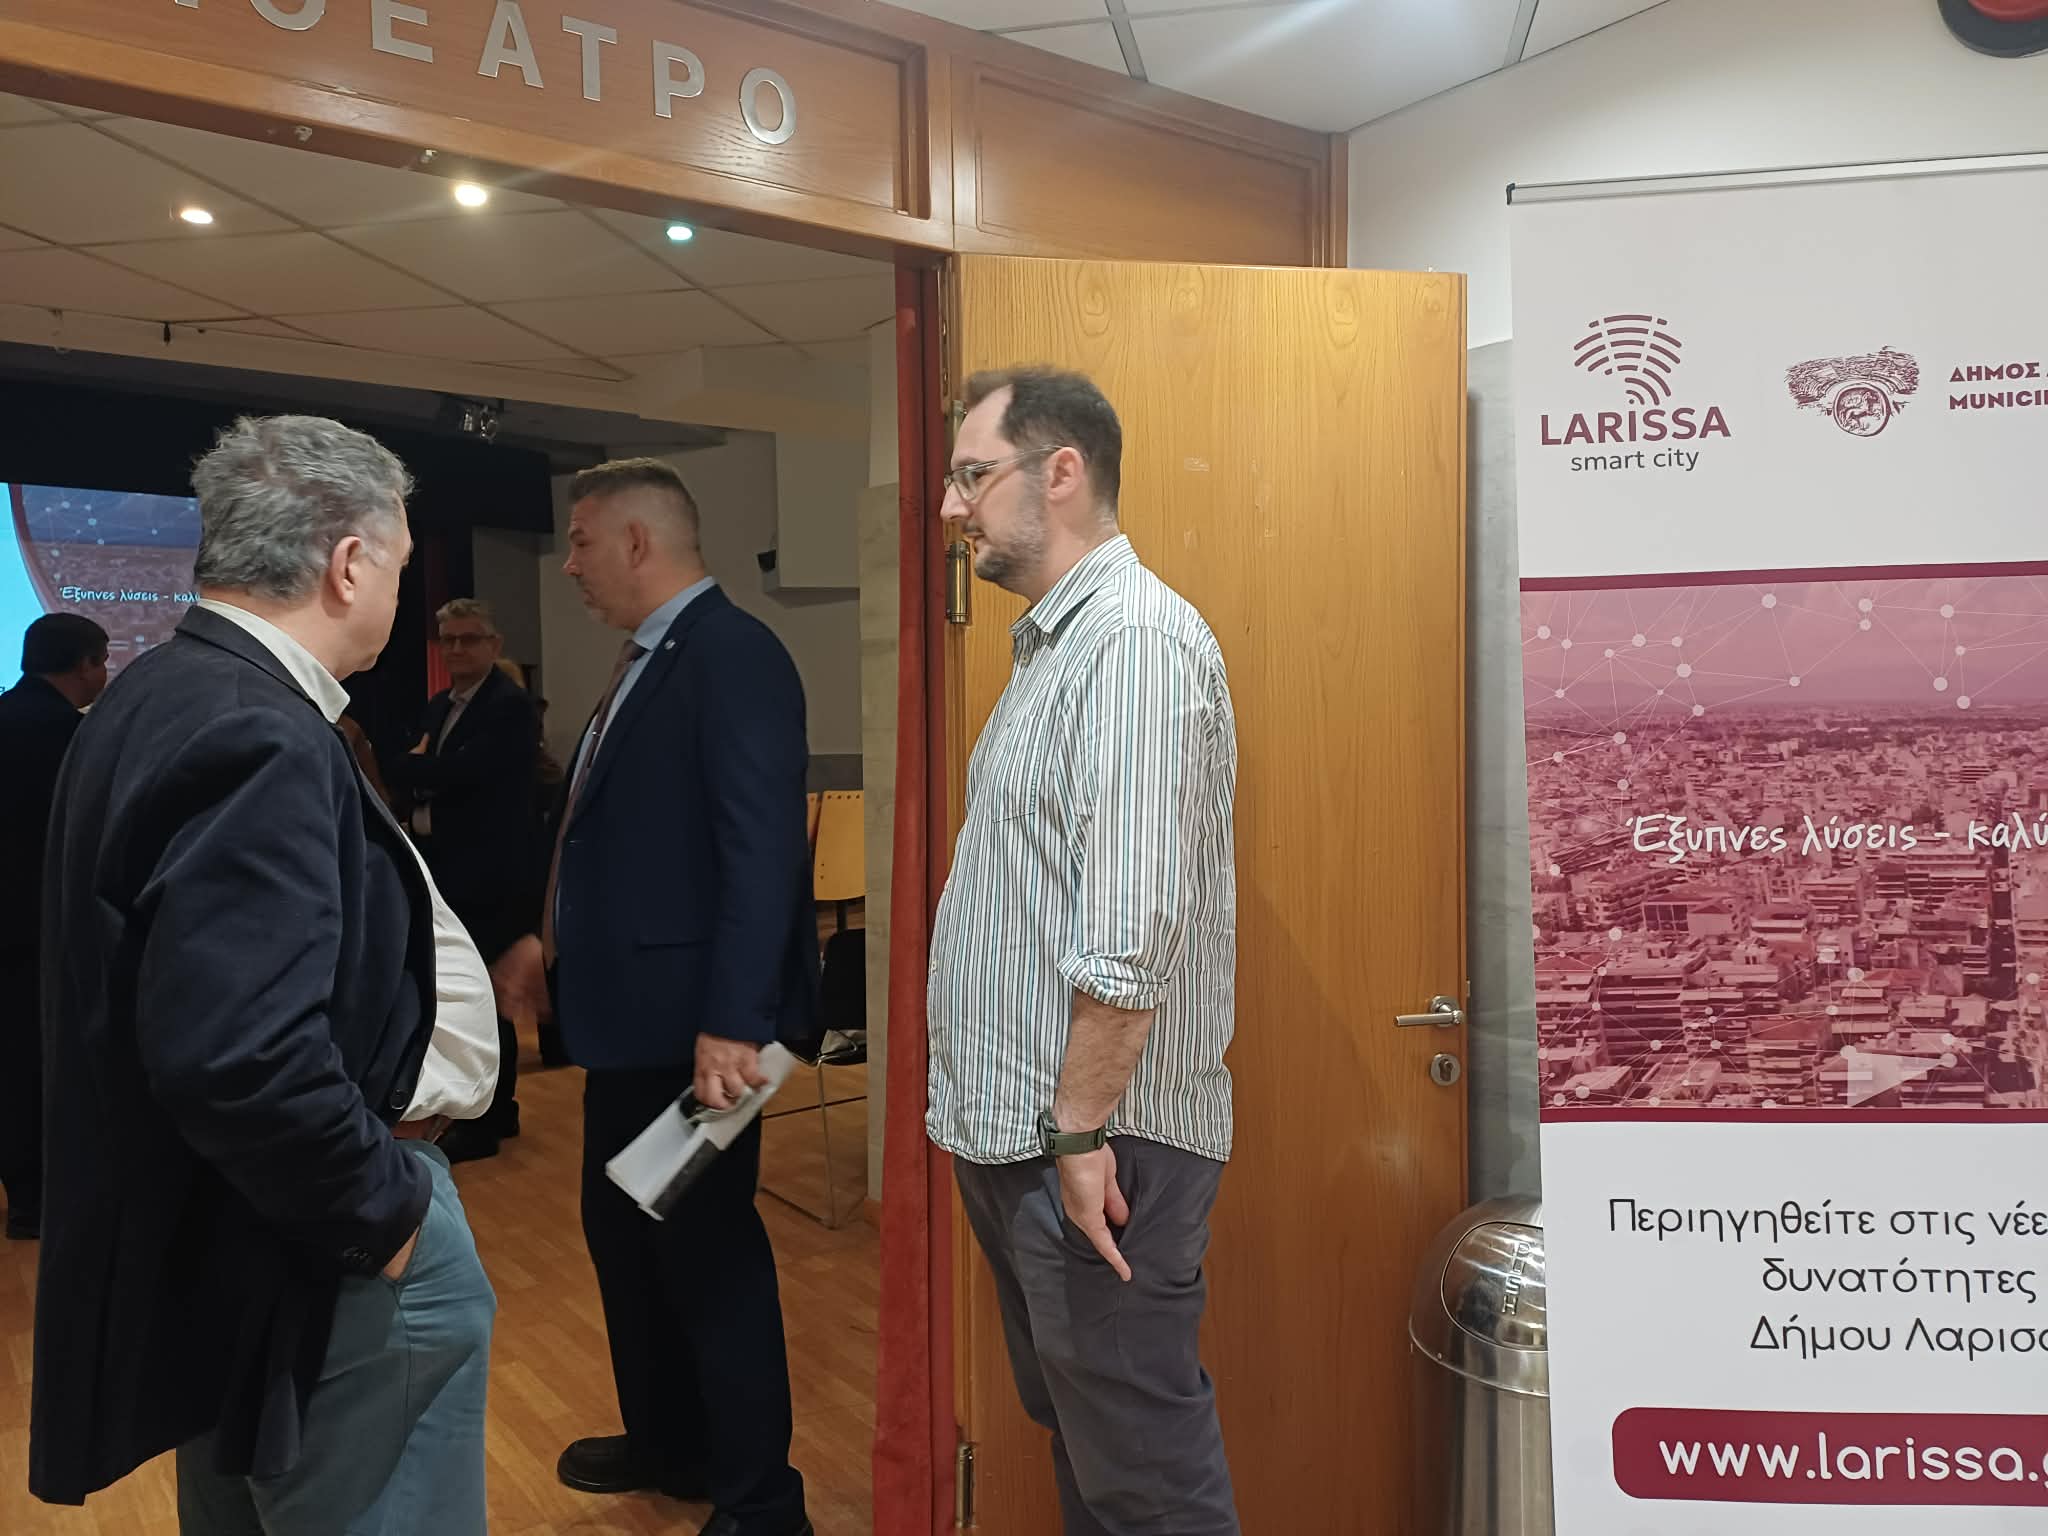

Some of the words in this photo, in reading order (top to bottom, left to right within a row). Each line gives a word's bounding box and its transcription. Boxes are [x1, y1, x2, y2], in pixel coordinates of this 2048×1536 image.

[1949, 362, 2041, 383] ΔΗΜΟΣ
[1949, 390, 2048, 410] MUNICI
[1570, 449, 1646, 472] smart
[1653, 447, 1700, 472] city
[59, 586, 116, 603] Έξυπνες
[119, 589, 159, 602] λύσεις
[1625, 813, 1787, 863] Έξυπνες
[1801, 814, 1918, 855] λύσεις
[1609, 1198, 1876, 1243] Περιηγηθείτε
[1889, 1209, 1976, 1245] στις
[1988, 1200, 2048, 1236] νέε
[1761, 1257, 2037, 1303] δυνατότητες
[1750, 1313, 1892, 1360] Δήμου
[1658, 1431, 2048, 1489] www.larissa.
